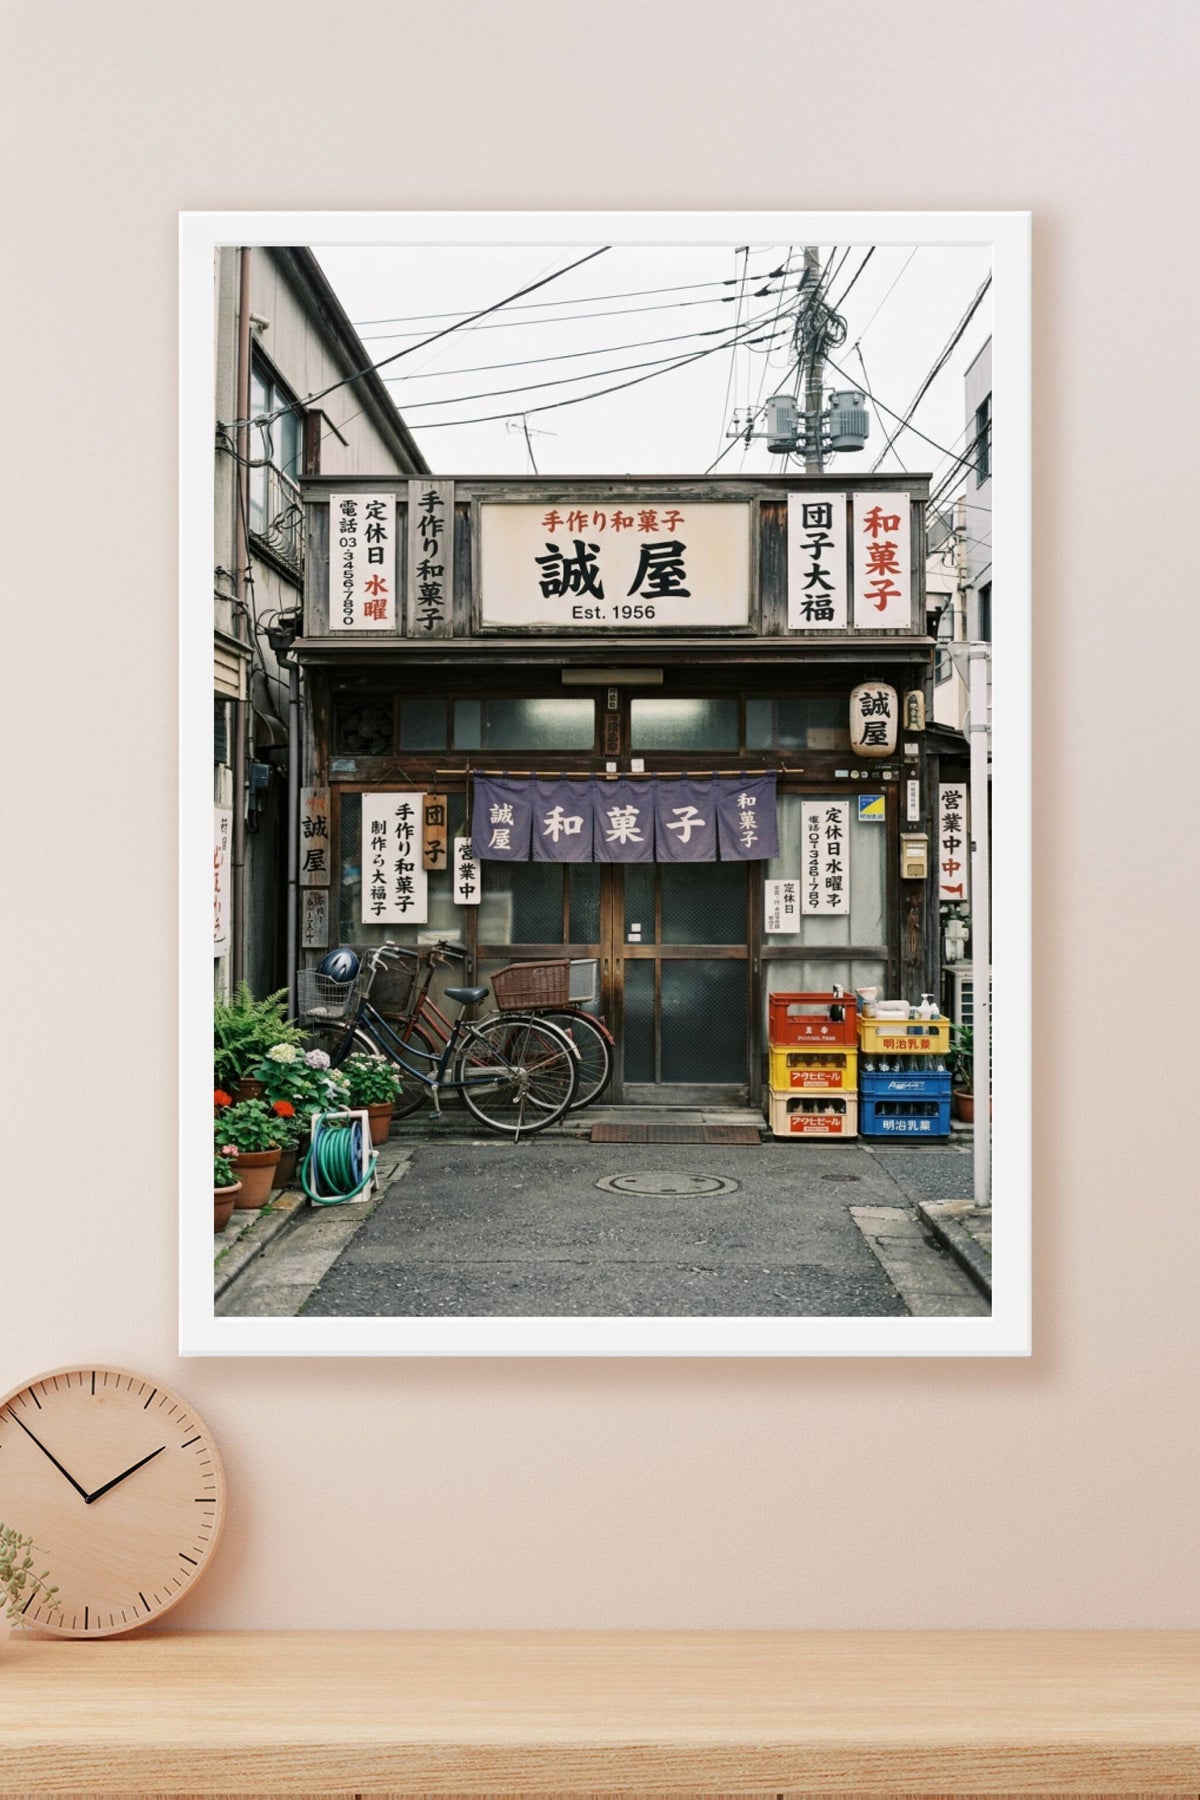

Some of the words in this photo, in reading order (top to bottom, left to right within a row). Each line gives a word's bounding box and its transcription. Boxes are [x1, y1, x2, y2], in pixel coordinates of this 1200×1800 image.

[364, 499, 388, 565] 定休日
[541, 509, 685, 534] 手作り和菓子
[416, 490, 445, 631] 手作り和菓子
[534, 539, 692, 601] 誠屋
[799, 501, 836, 622] 団子大福
[863, 505, 902, 612] 和菓子
[363, 574, 389, 621] 水曜
[572, 605, 606, 620] Est.
[612, 605, 656, 620] 1956
[858, 691, 891, 747] 誠屋
[301, 815, 329, 872] 誠屋
[424, 804, 445, 863] 団子
[487, 803, 514, 850] 誠屋
[542, 804, 706, 845] 和菓子
[737, 792, 759, 849] 和菓子
[394, 802, 415, 913] 手作り和菓子
[458, 843, 476, 900] 営業中
[783, 882, 796, 914] 定休日
